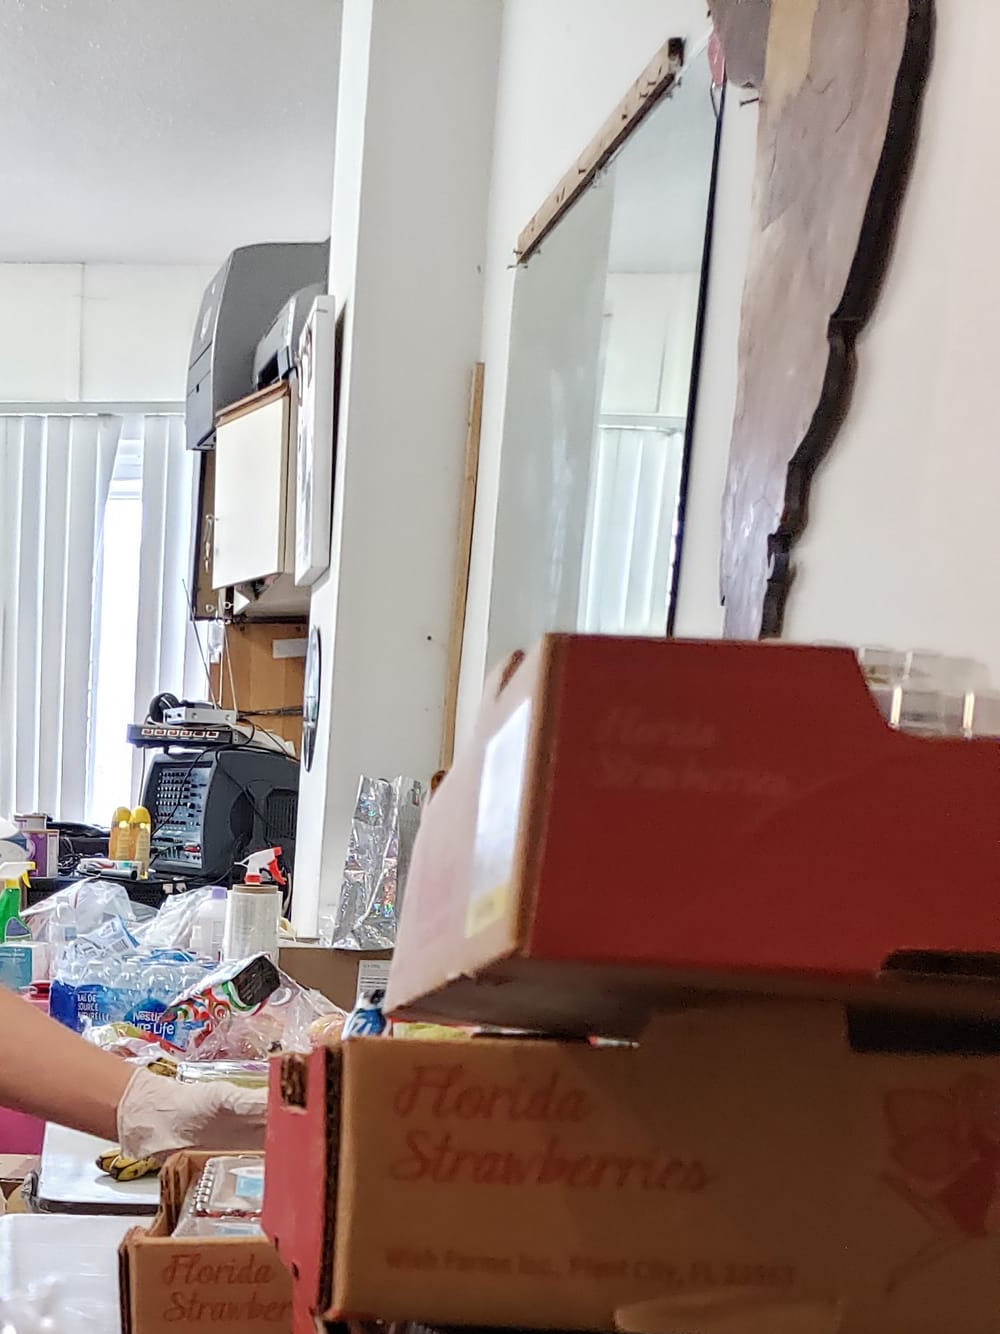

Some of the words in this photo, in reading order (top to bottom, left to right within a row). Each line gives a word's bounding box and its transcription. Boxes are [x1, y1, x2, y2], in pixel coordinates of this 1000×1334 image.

[153, 1022, 175, 1039] Life
[392, 1062, 588, 1123] Florida
[389, 1129, 713, 1194] Strawberries
[161, 1253, 277, 1285] Florida
[161, 1290, 293, 1322] Strawber
